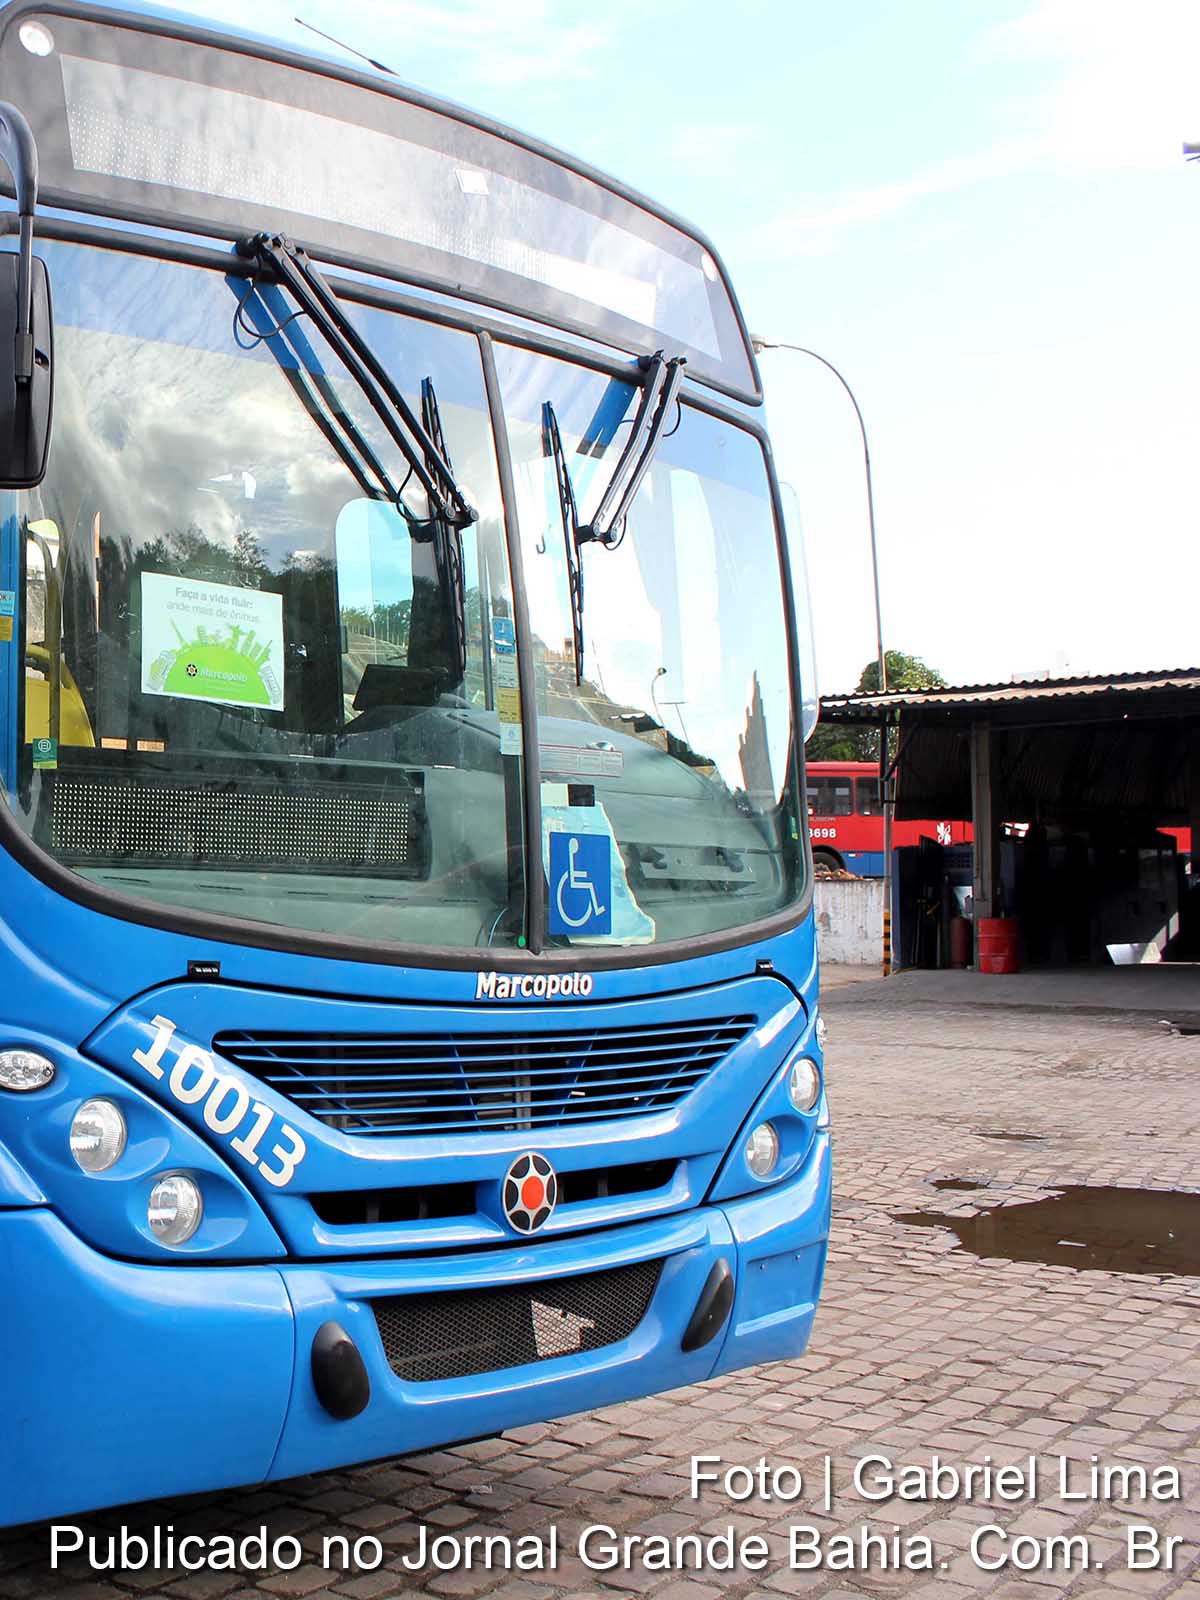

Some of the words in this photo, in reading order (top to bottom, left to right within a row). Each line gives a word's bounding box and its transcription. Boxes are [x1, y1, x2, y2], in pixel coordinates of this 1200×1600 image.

[175, 586, 199, 601] Faça
[200, 592, 207, 600] a
[209, 592, 230, 604] vida
[166, 601, 190, 613] ande
[215, 607, 229, 618] de
[475, 971, 594, 1000] Marcopolo
[132, 1014, 306, 1188] 10013
